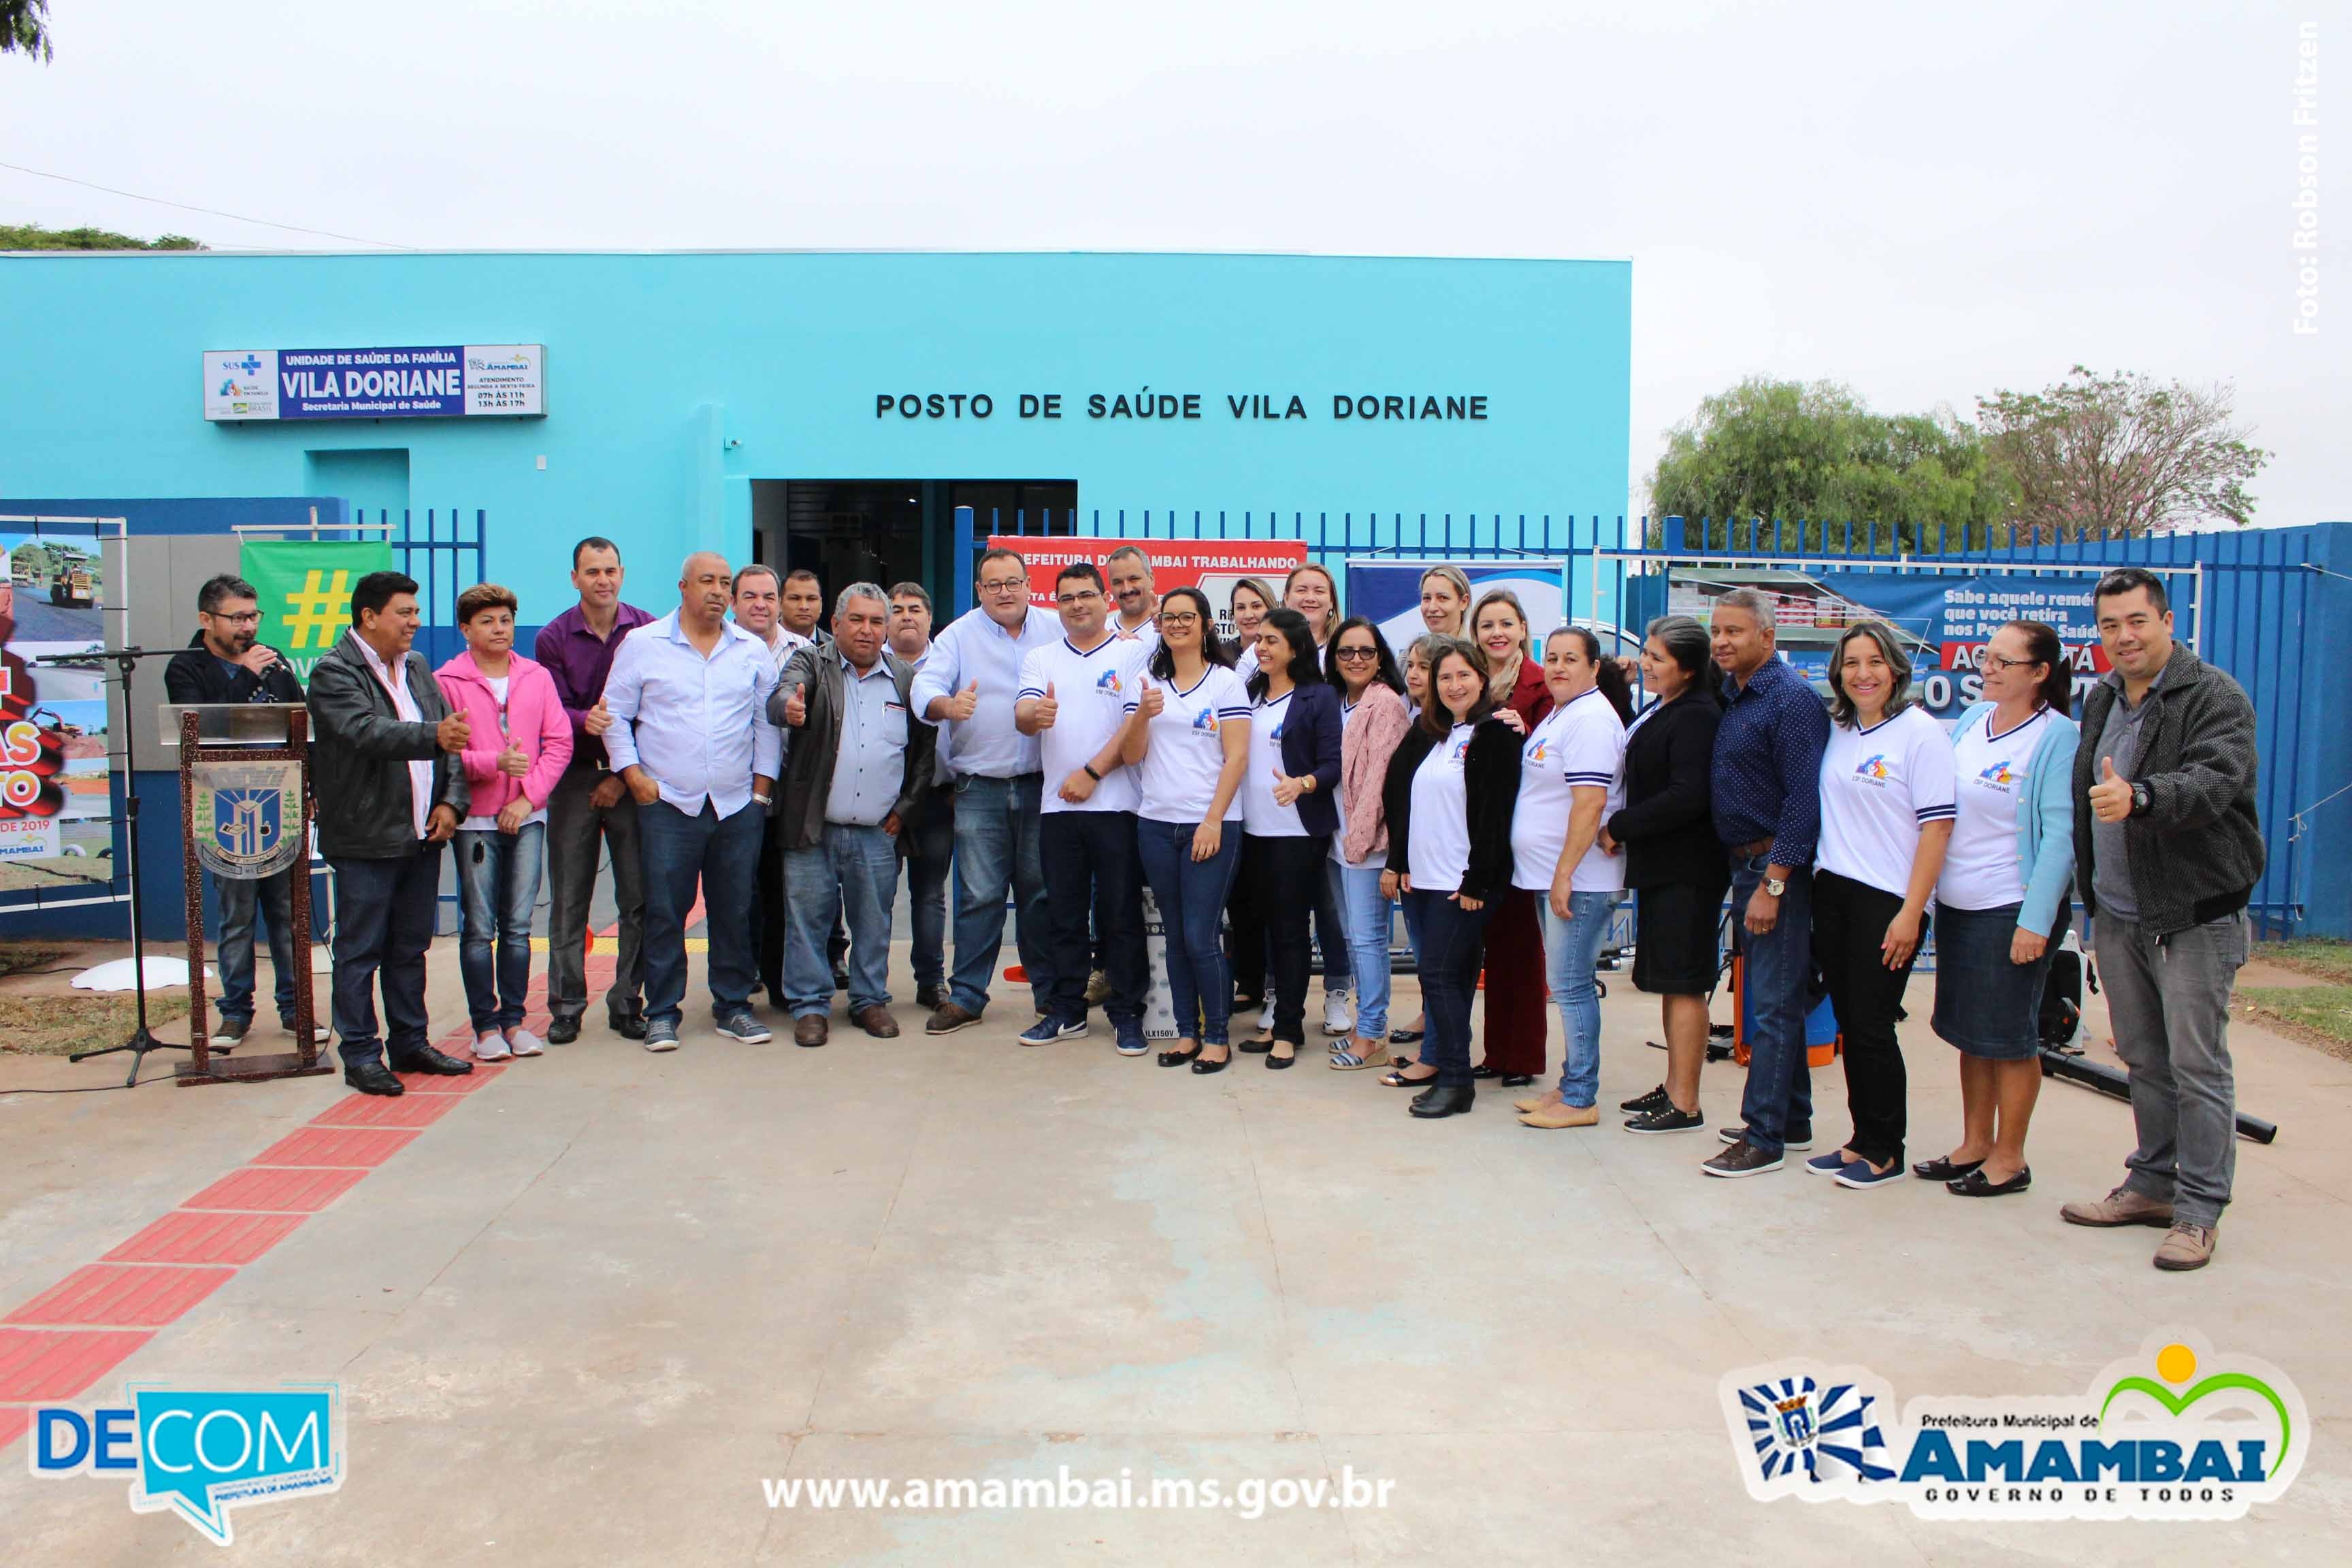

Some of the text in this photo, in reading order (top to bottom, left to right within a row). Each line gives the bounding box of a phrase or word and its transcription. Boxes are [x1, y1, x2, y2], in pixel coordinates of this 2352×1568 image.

[286, 350, 457, 365] UNIDADE DE SAÚDE DA FAMÍLIA
[223, 361, 240, 370] SUS
[281, 369, 461, 398] VILA DORIANE
[302, 400, 442, 412] Secretaria Municipal de Saúde
[876, 387, 1488, 421] POSTO DE SAÚDE VILA DORIANE
[1019, 553, 1093, 566] EFEITURA
[1191, 556, 1298, 569] TRABALHANDO
[1944, 589, 1986, 605] Sabe
[1988, 591, 2045, 607] aquele
[1944, 607, 2068, 623] que você retira
[1944, 624, 1973, 636] nos
[1925, 675, 1951, 707] O
[1861, 777, 1886, 788] DORIANE
[1983, 781, 2010, 794] DORIANE
[21, 820, 50, 831] 2019
[0, 846, 44, 854] MAMBAI
